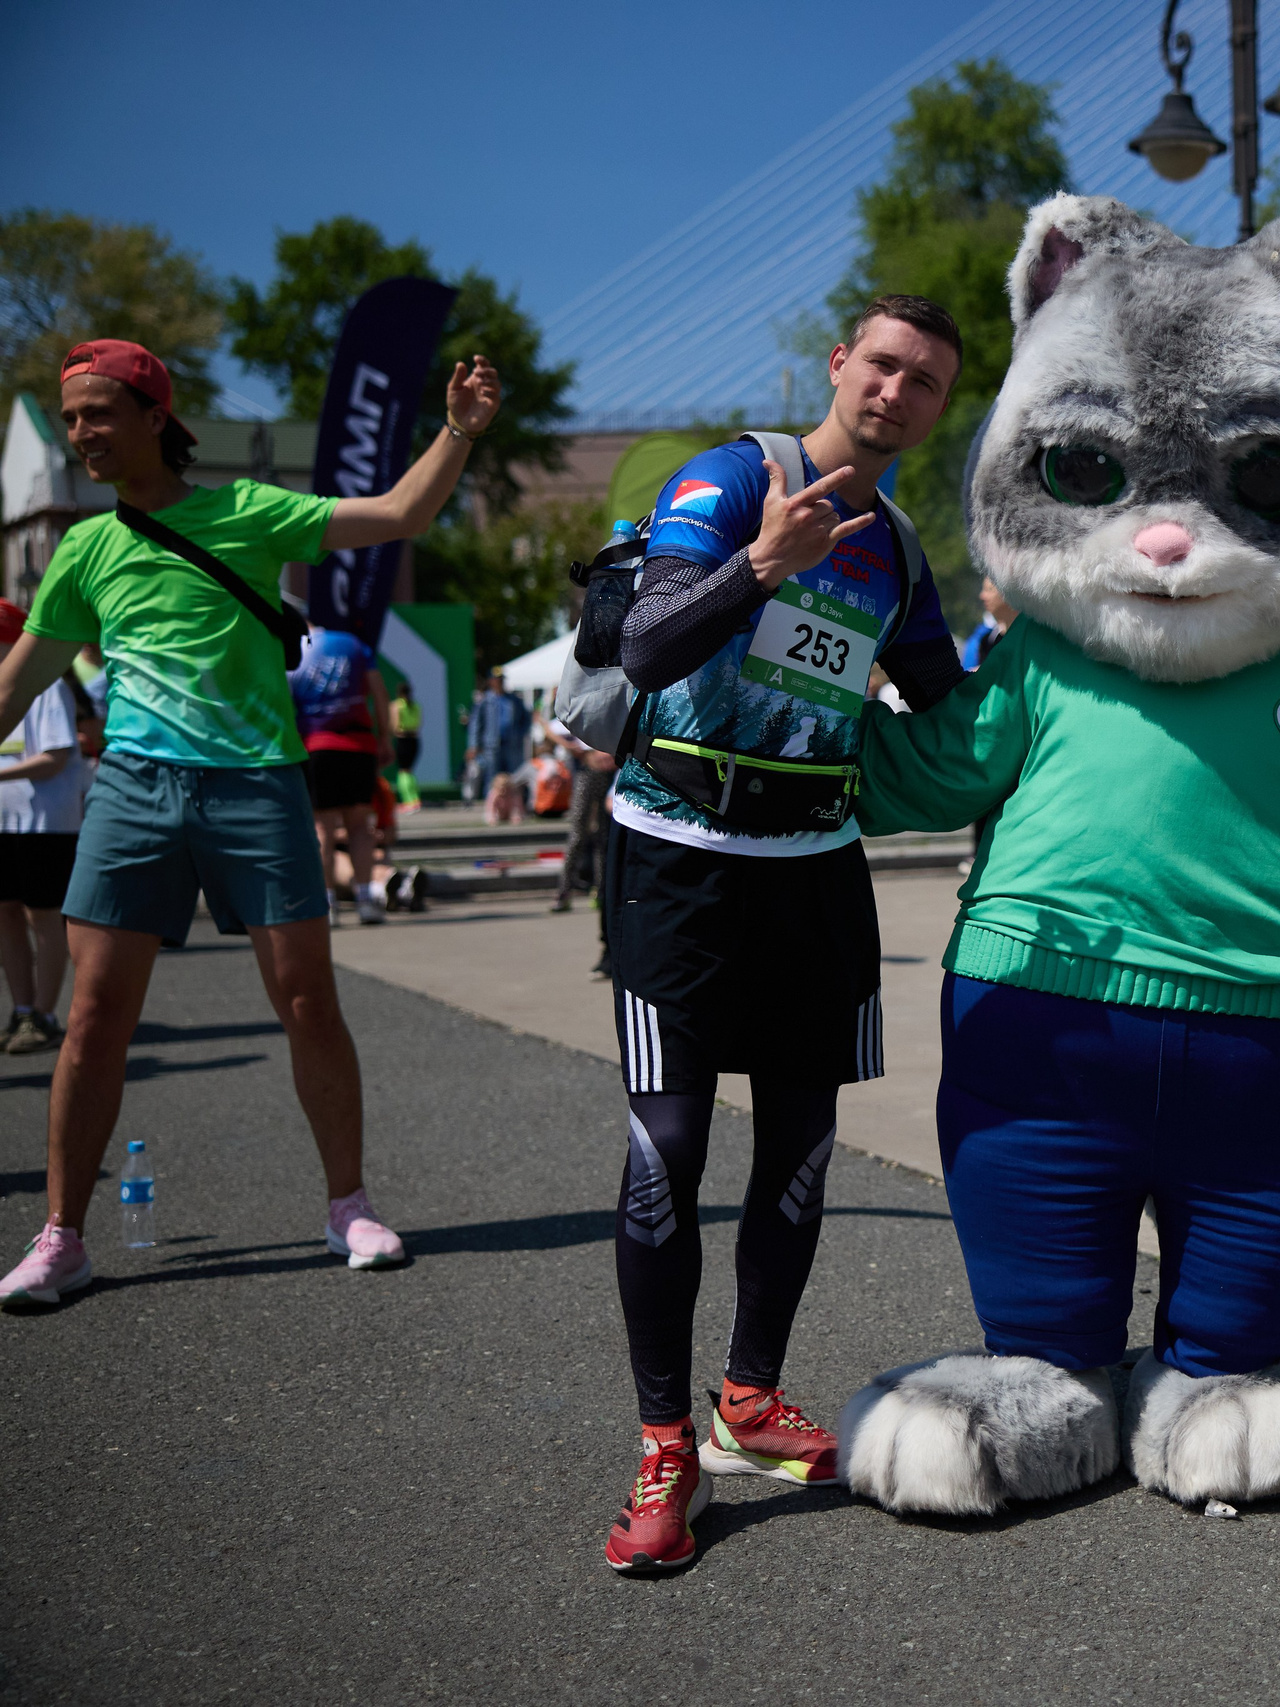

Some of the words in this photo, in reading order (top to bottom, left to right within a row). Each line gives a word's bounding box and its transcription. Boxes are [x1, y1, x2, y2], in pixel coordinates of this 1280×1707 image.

[827, 606, 844, 619] Звук
[786, 623, 850, 675] 253
[769, 667, 783, 685] A
